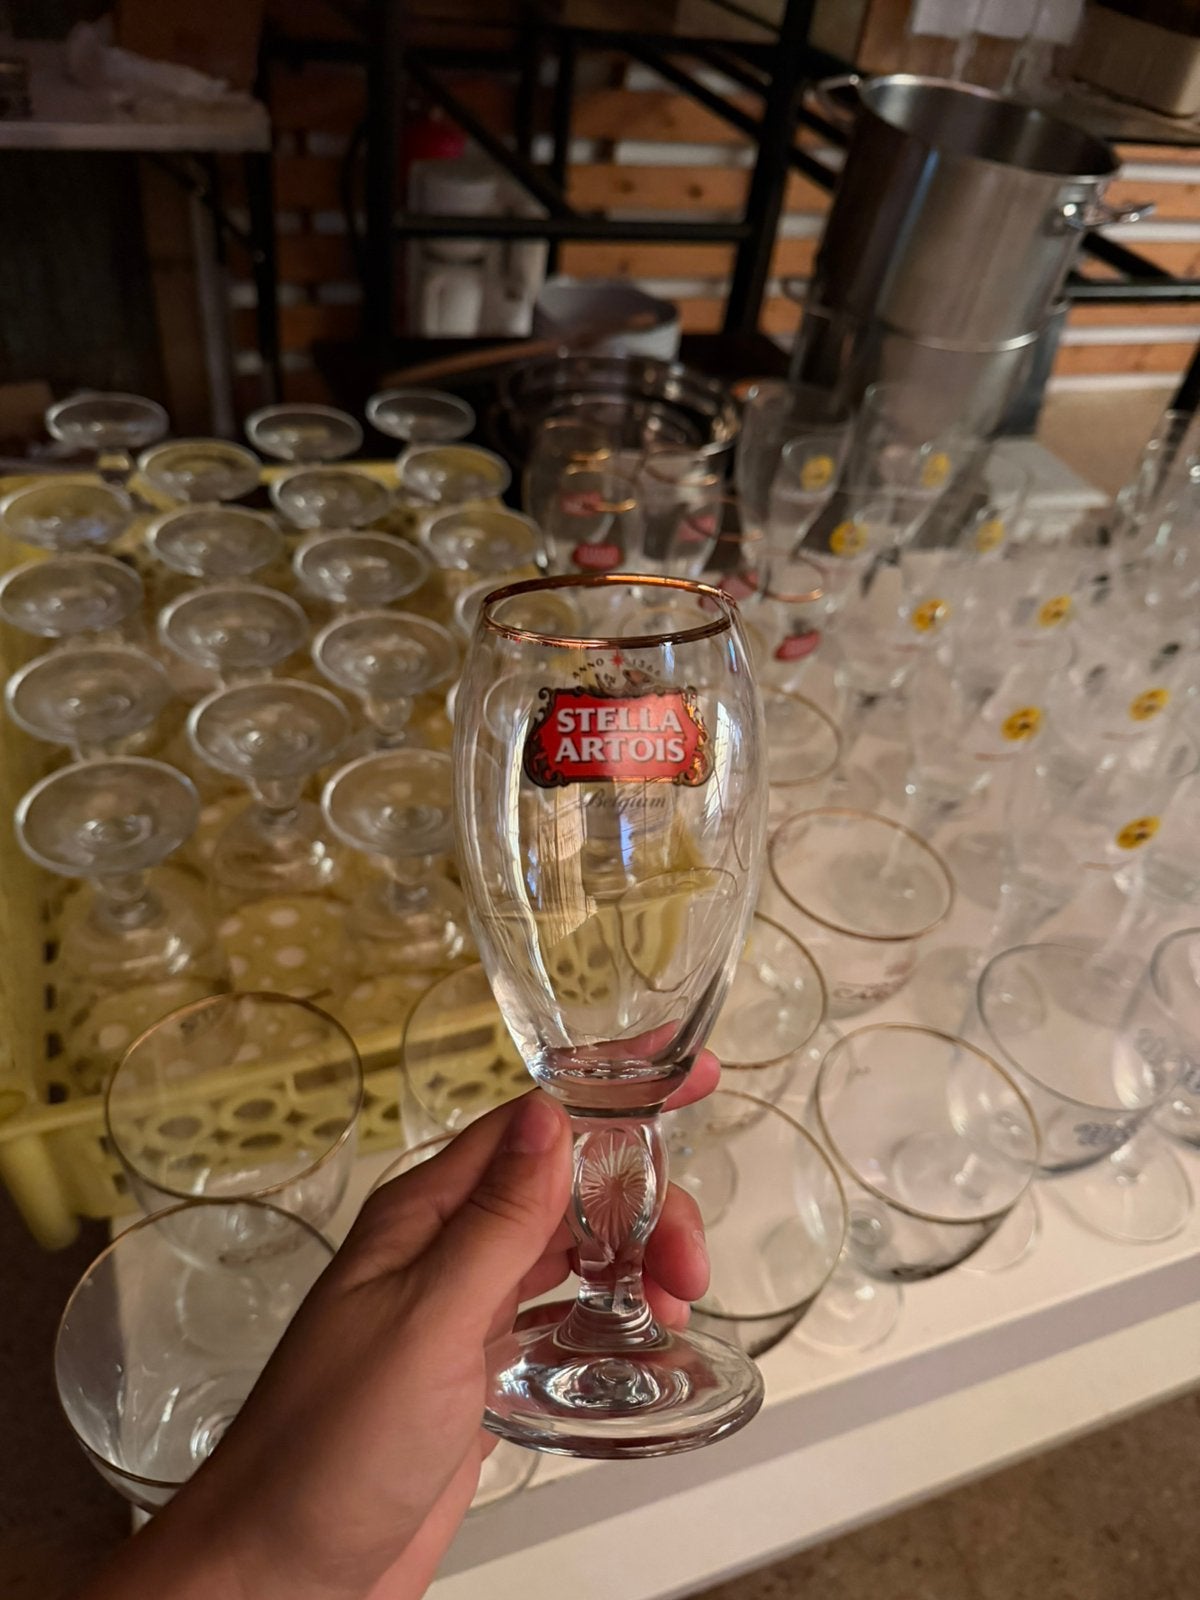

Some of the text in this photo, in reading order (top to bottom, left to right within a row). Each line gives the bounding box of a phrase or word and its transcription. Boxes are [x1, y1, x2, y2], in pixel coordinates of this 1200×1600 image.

[572, 658, 605, 679] ANNO
[557, 706, 683, 733] STELLA
[555, 737, 685, 762] ARTOIS
[585, 787, 666, 814] Belgium
